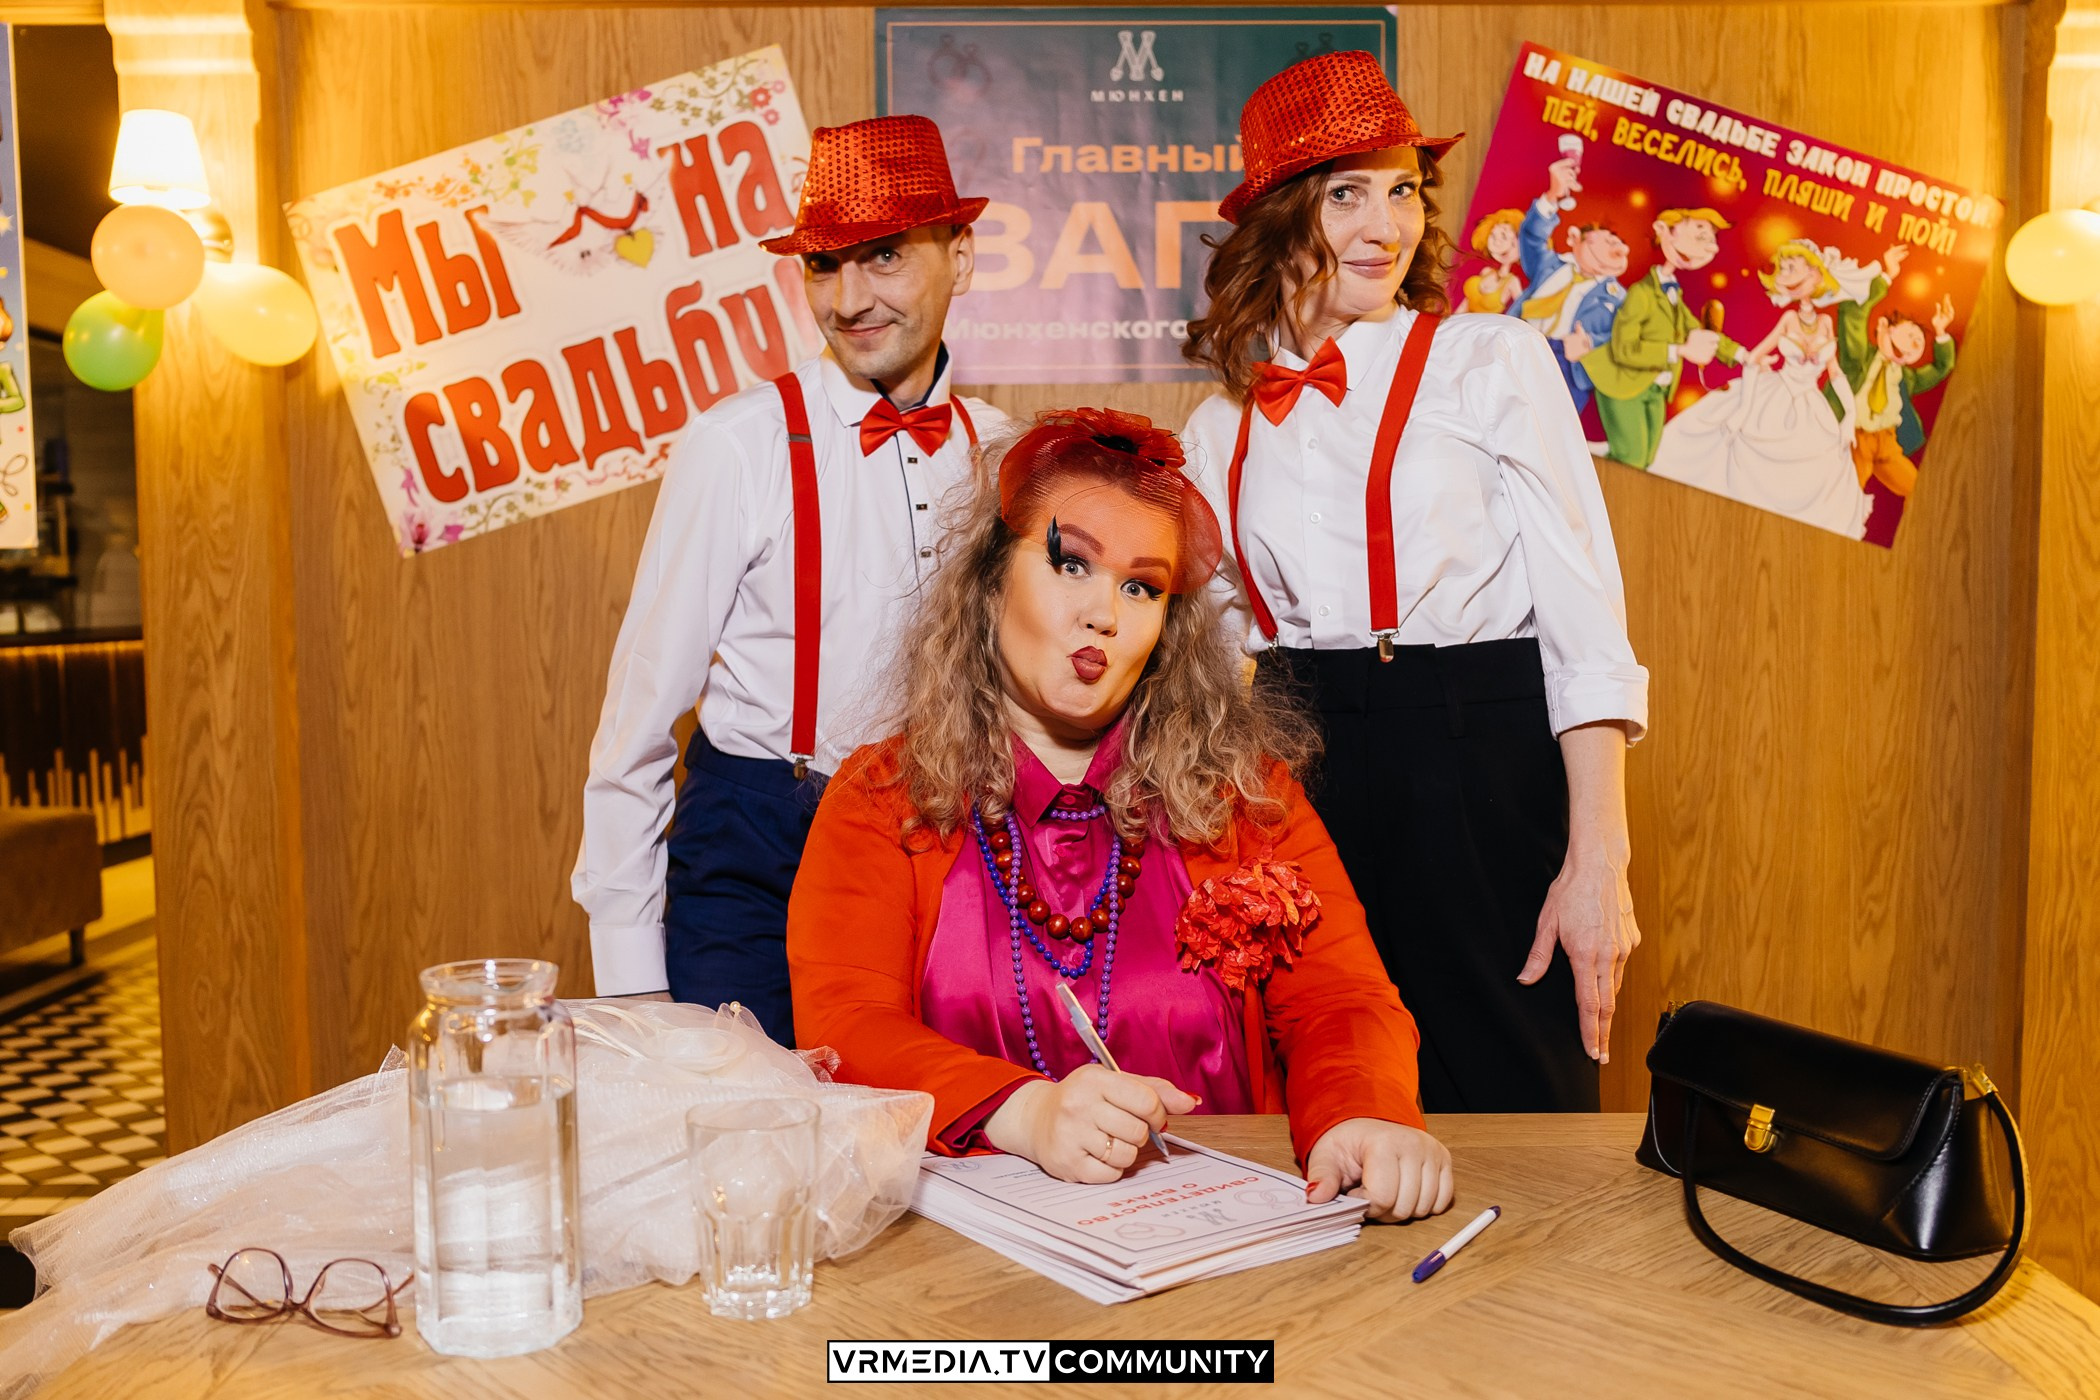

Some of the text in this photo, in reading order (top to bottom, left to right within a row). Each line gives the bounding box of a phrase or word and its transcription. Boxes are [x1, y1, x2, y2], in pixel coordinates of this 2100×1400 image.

[1090, 89, 1184, 102] МЮНХЕН
[1523, 51, 1561, 85] НА
[1566, 66, 1662, 117] НАШЕЙ
[1666, 98, 1782, 159] СВАДЬБЕ
[1786, 139, 1873, 188] ЗАКОН
[1542, 95, 1957, 256] ПЕЙ, ВЕСЕЛИСЬ, ПЛЯШИ И ПОЙ!
[334, 120, 797, 358] Мы на
[1077, 1176, 1260, 1226] СВИДЕТЕЛЬСТВО
[1107, 1187, 1178, 1208] БРАКЕ
